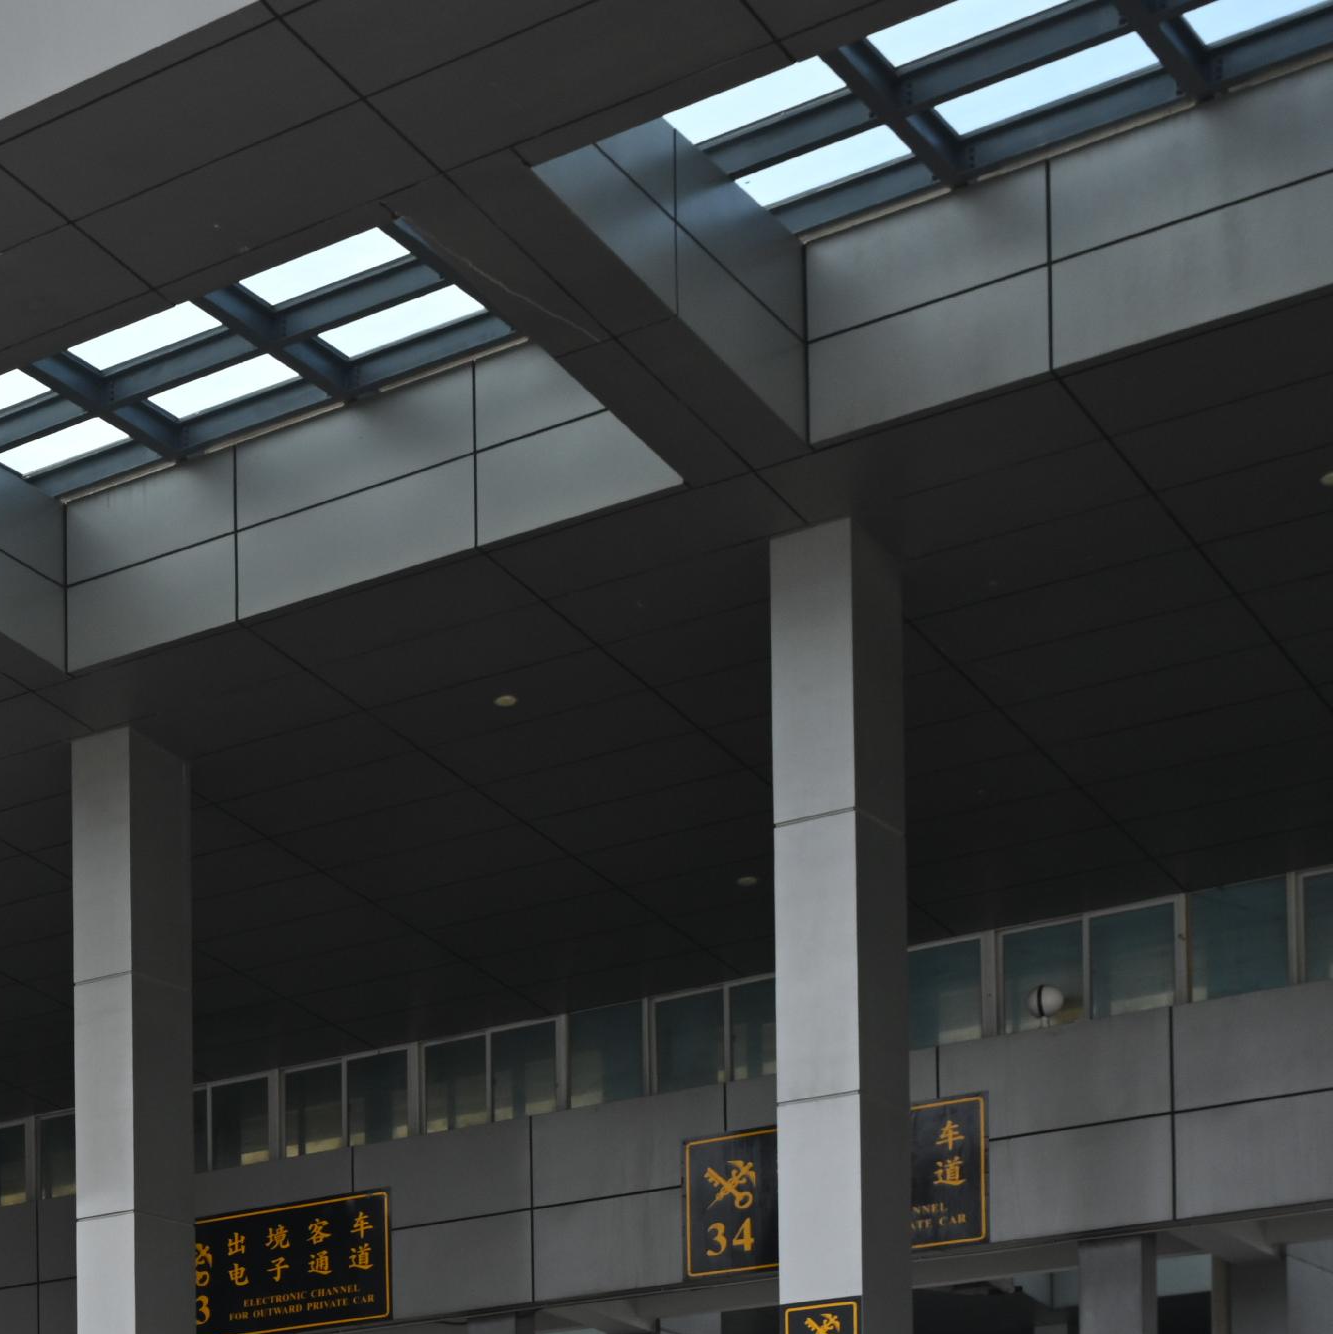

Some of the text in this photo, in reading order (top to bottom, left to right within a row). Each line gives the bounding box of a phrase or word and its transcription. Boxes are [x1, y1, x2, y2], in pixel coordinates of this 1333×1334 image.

[911, 1201, 948, 1215] NNEL
[227, 1211, 374, 1256] 出境客车
[706, 1217, 755, 1257] 34
[228, 1243, 374, 1286] 电子通道
[229, 1294, 375, 1322] FOR OUTWARD PRIVATE CAR
[243, 1284, 360, 1308] ELECTRONIC CHANNEL
